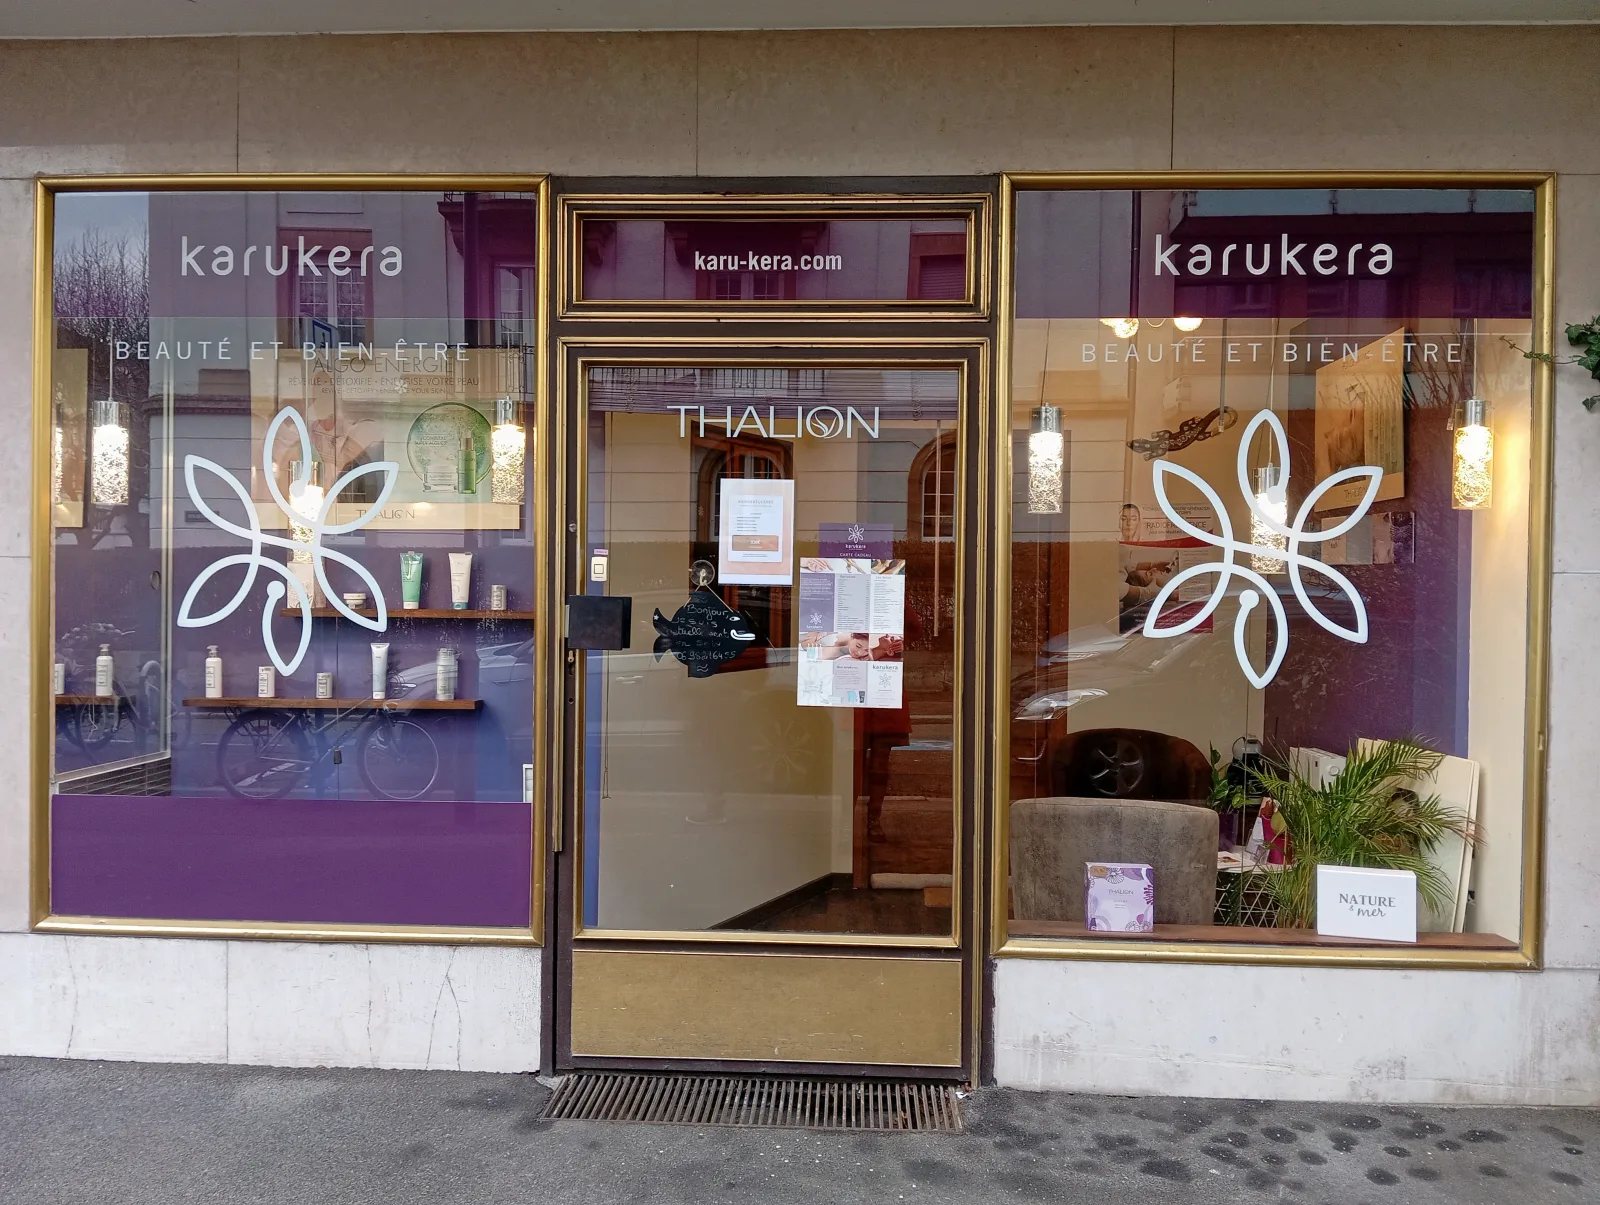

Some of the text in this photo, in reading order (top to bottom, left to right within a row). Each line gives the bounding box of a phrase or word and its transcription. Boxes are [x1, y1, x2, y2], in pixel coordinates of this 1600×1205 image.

[181, 235, 404, 277] karukera
[694, 250, 843, 271] karu-kera.com
[1155, 233, 1393, 276] karukera
[115, 337, 470, 362] BEAUTÉ ET BIEN-ÊTRE
[1082, 338, 1206, 363] BEAUTÉ
[1227, 342, 1263, 363] ET
[1283, 338, 1462, 363] BIEN-ÊTRE
[667, 405, 880, 439] THALION
[356, 508, 415, 519] TALION
[1338, 893, 1396, 908] NATURE
[1356, 907, 1387, 918] mer
